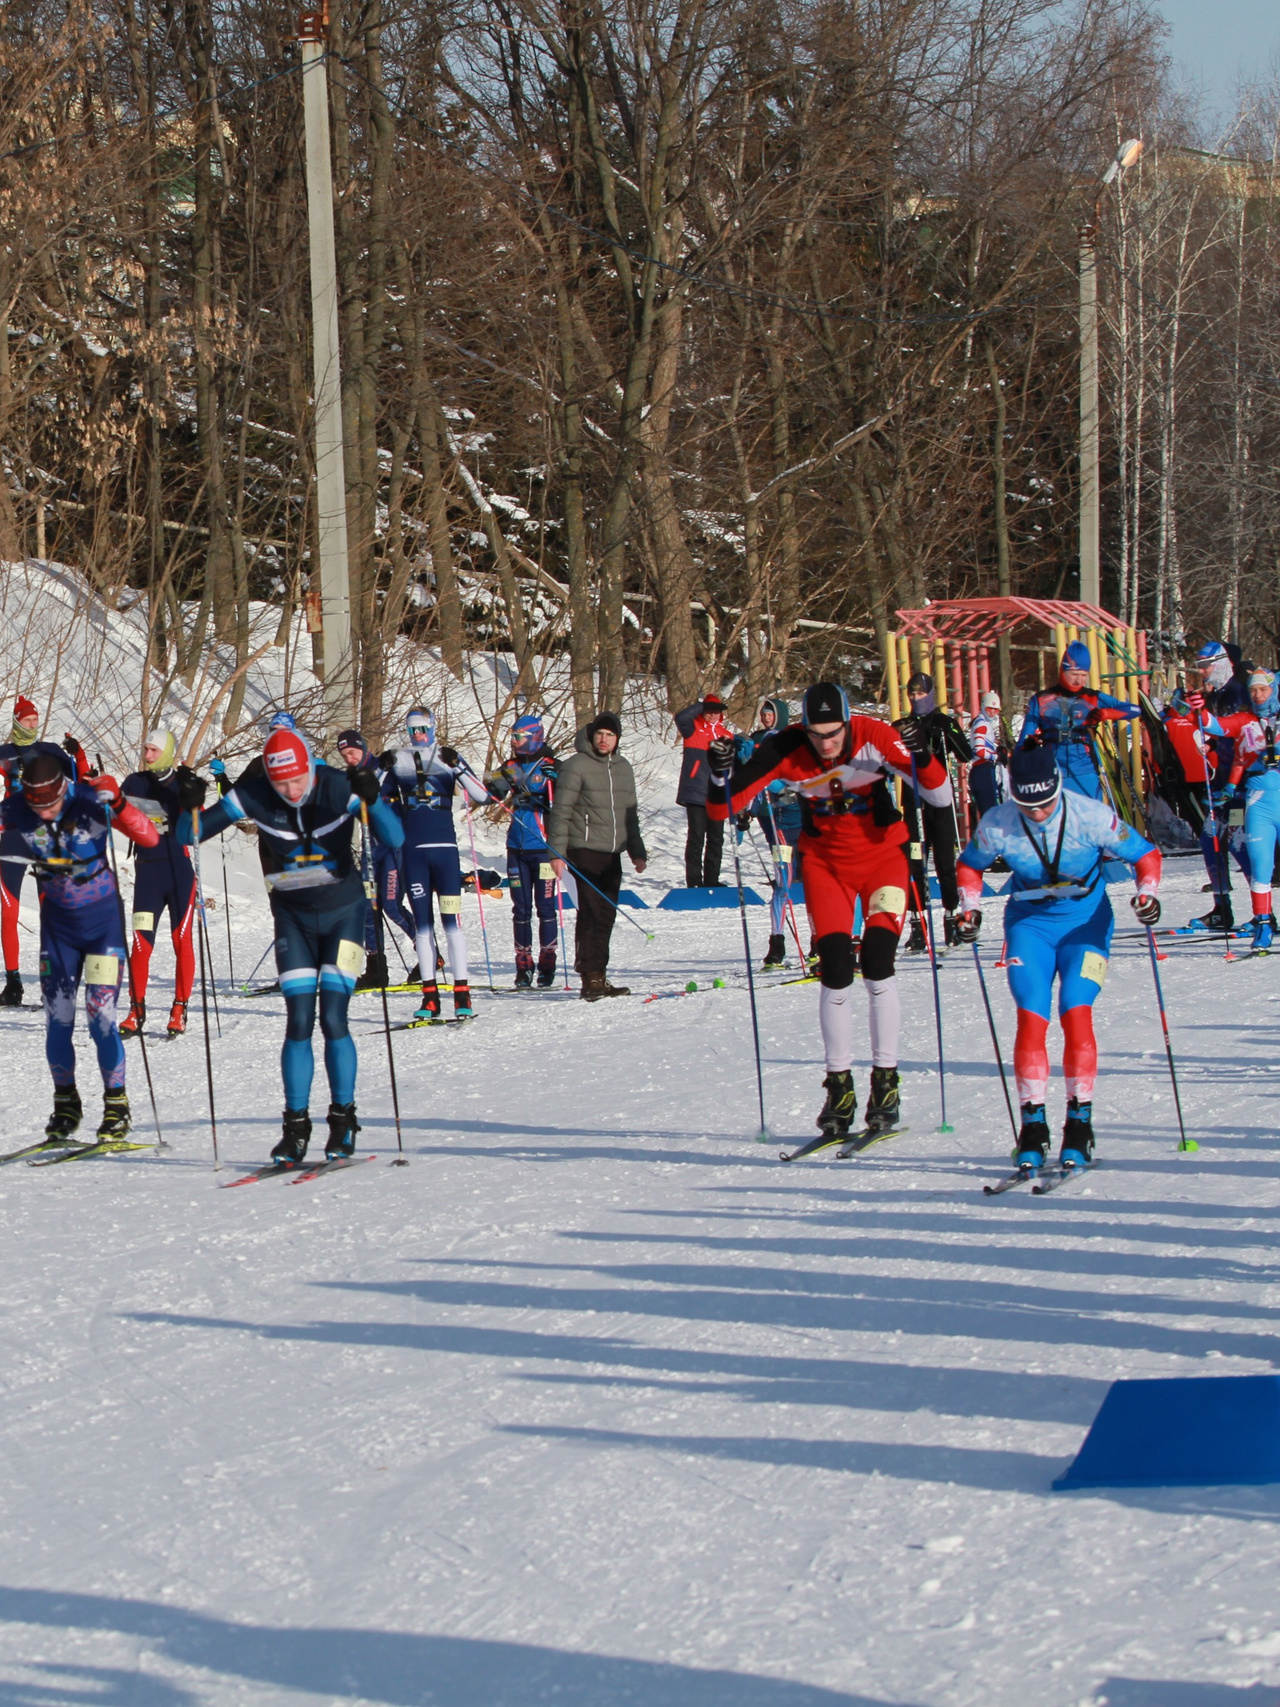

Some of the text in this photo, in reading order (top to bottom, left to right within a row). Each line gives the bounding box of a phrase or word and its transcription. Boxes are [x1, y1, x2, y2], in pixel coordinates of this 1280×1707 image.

[387, 869, 398, 900] RUSSIA
[880, 893, 886, 901] 2
[94, 962, 100, 970] 4
